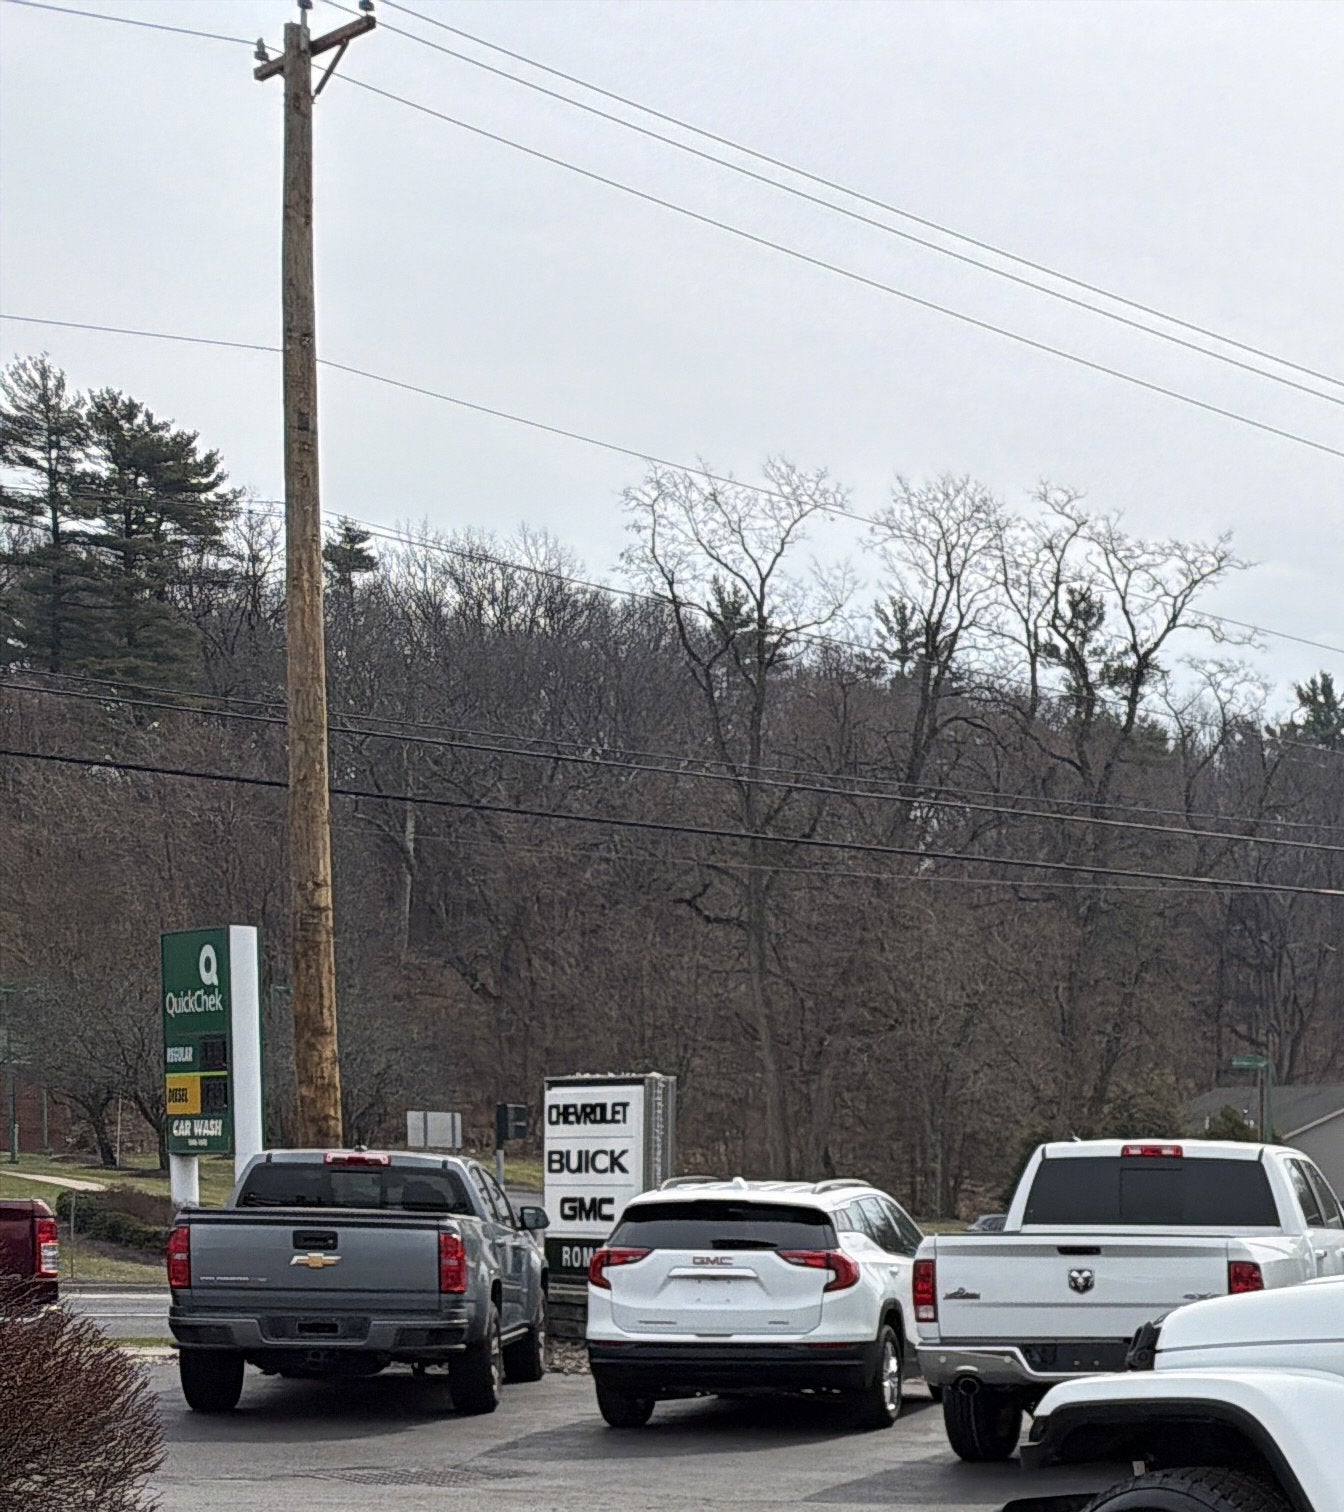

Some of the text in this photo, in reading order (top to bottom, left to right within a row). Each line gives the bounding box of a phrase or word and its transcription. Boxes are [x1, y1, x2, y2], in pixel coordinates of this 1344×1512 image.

[165, 987, 224, 1018] QuickChek
[547, 1102, 630, 1125] CHEVROLET
[172, 1119, 223, 1137] CAR WASH
[547, 1149, 630, 1174] BUICK
[560, 1196, 615, 1222] GMC
[692, 1256, 733, 1266] GMC
